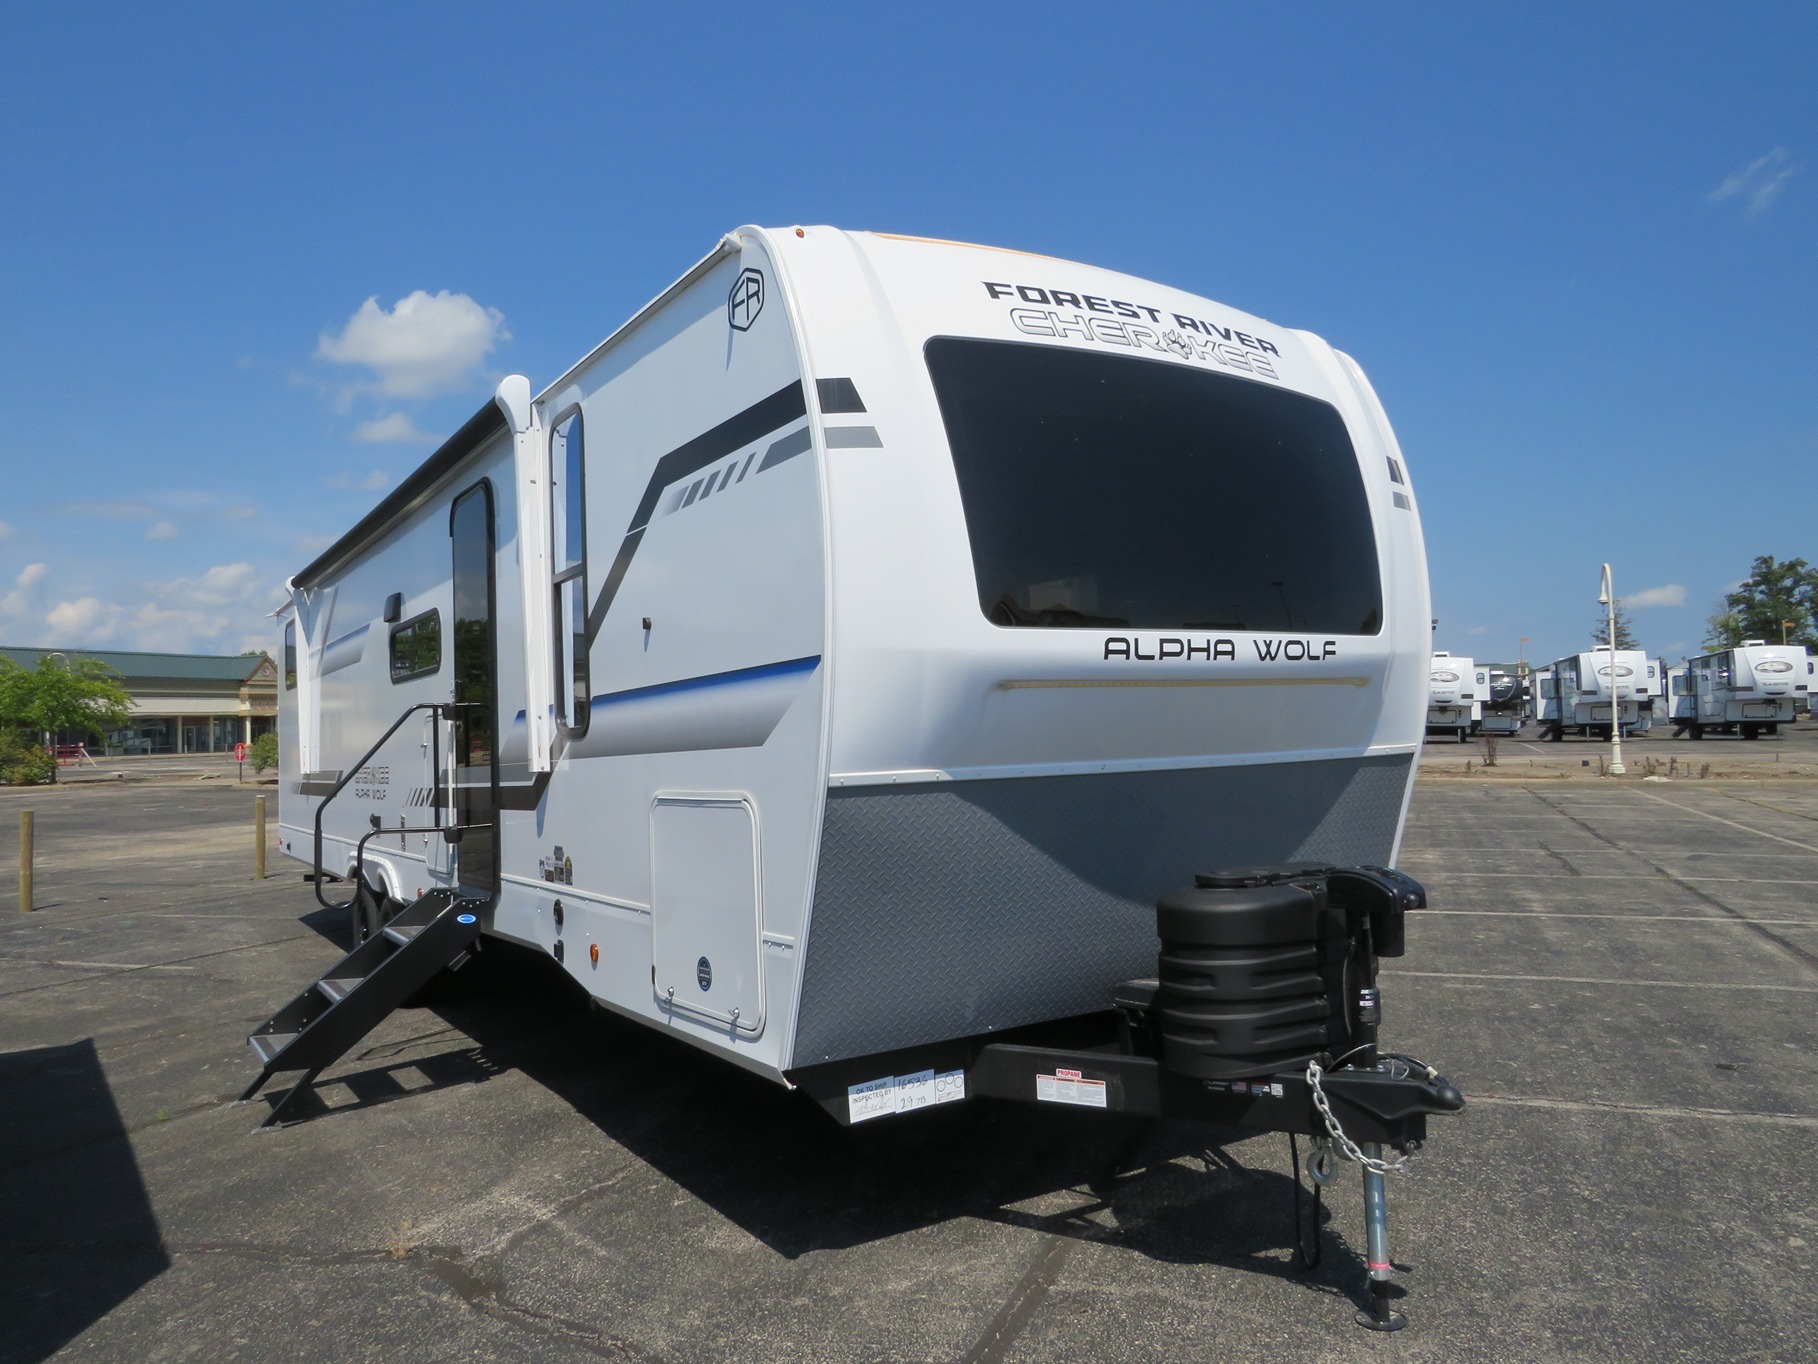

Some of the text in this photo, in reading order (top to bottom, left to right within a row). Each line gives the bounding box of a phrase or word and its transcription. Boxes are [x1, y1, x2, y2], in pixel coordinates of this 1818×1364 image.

[980, 281, 1281, 358] FOREST RIVER
[1103, 636, 1337, 662] ALPHA WOLF
[1057, 1069, 1081, 1078] PROPANE
[874, 1081, 888, 1091] SHIP
[852, 1089, 892, 1104] INSPECTED BY
